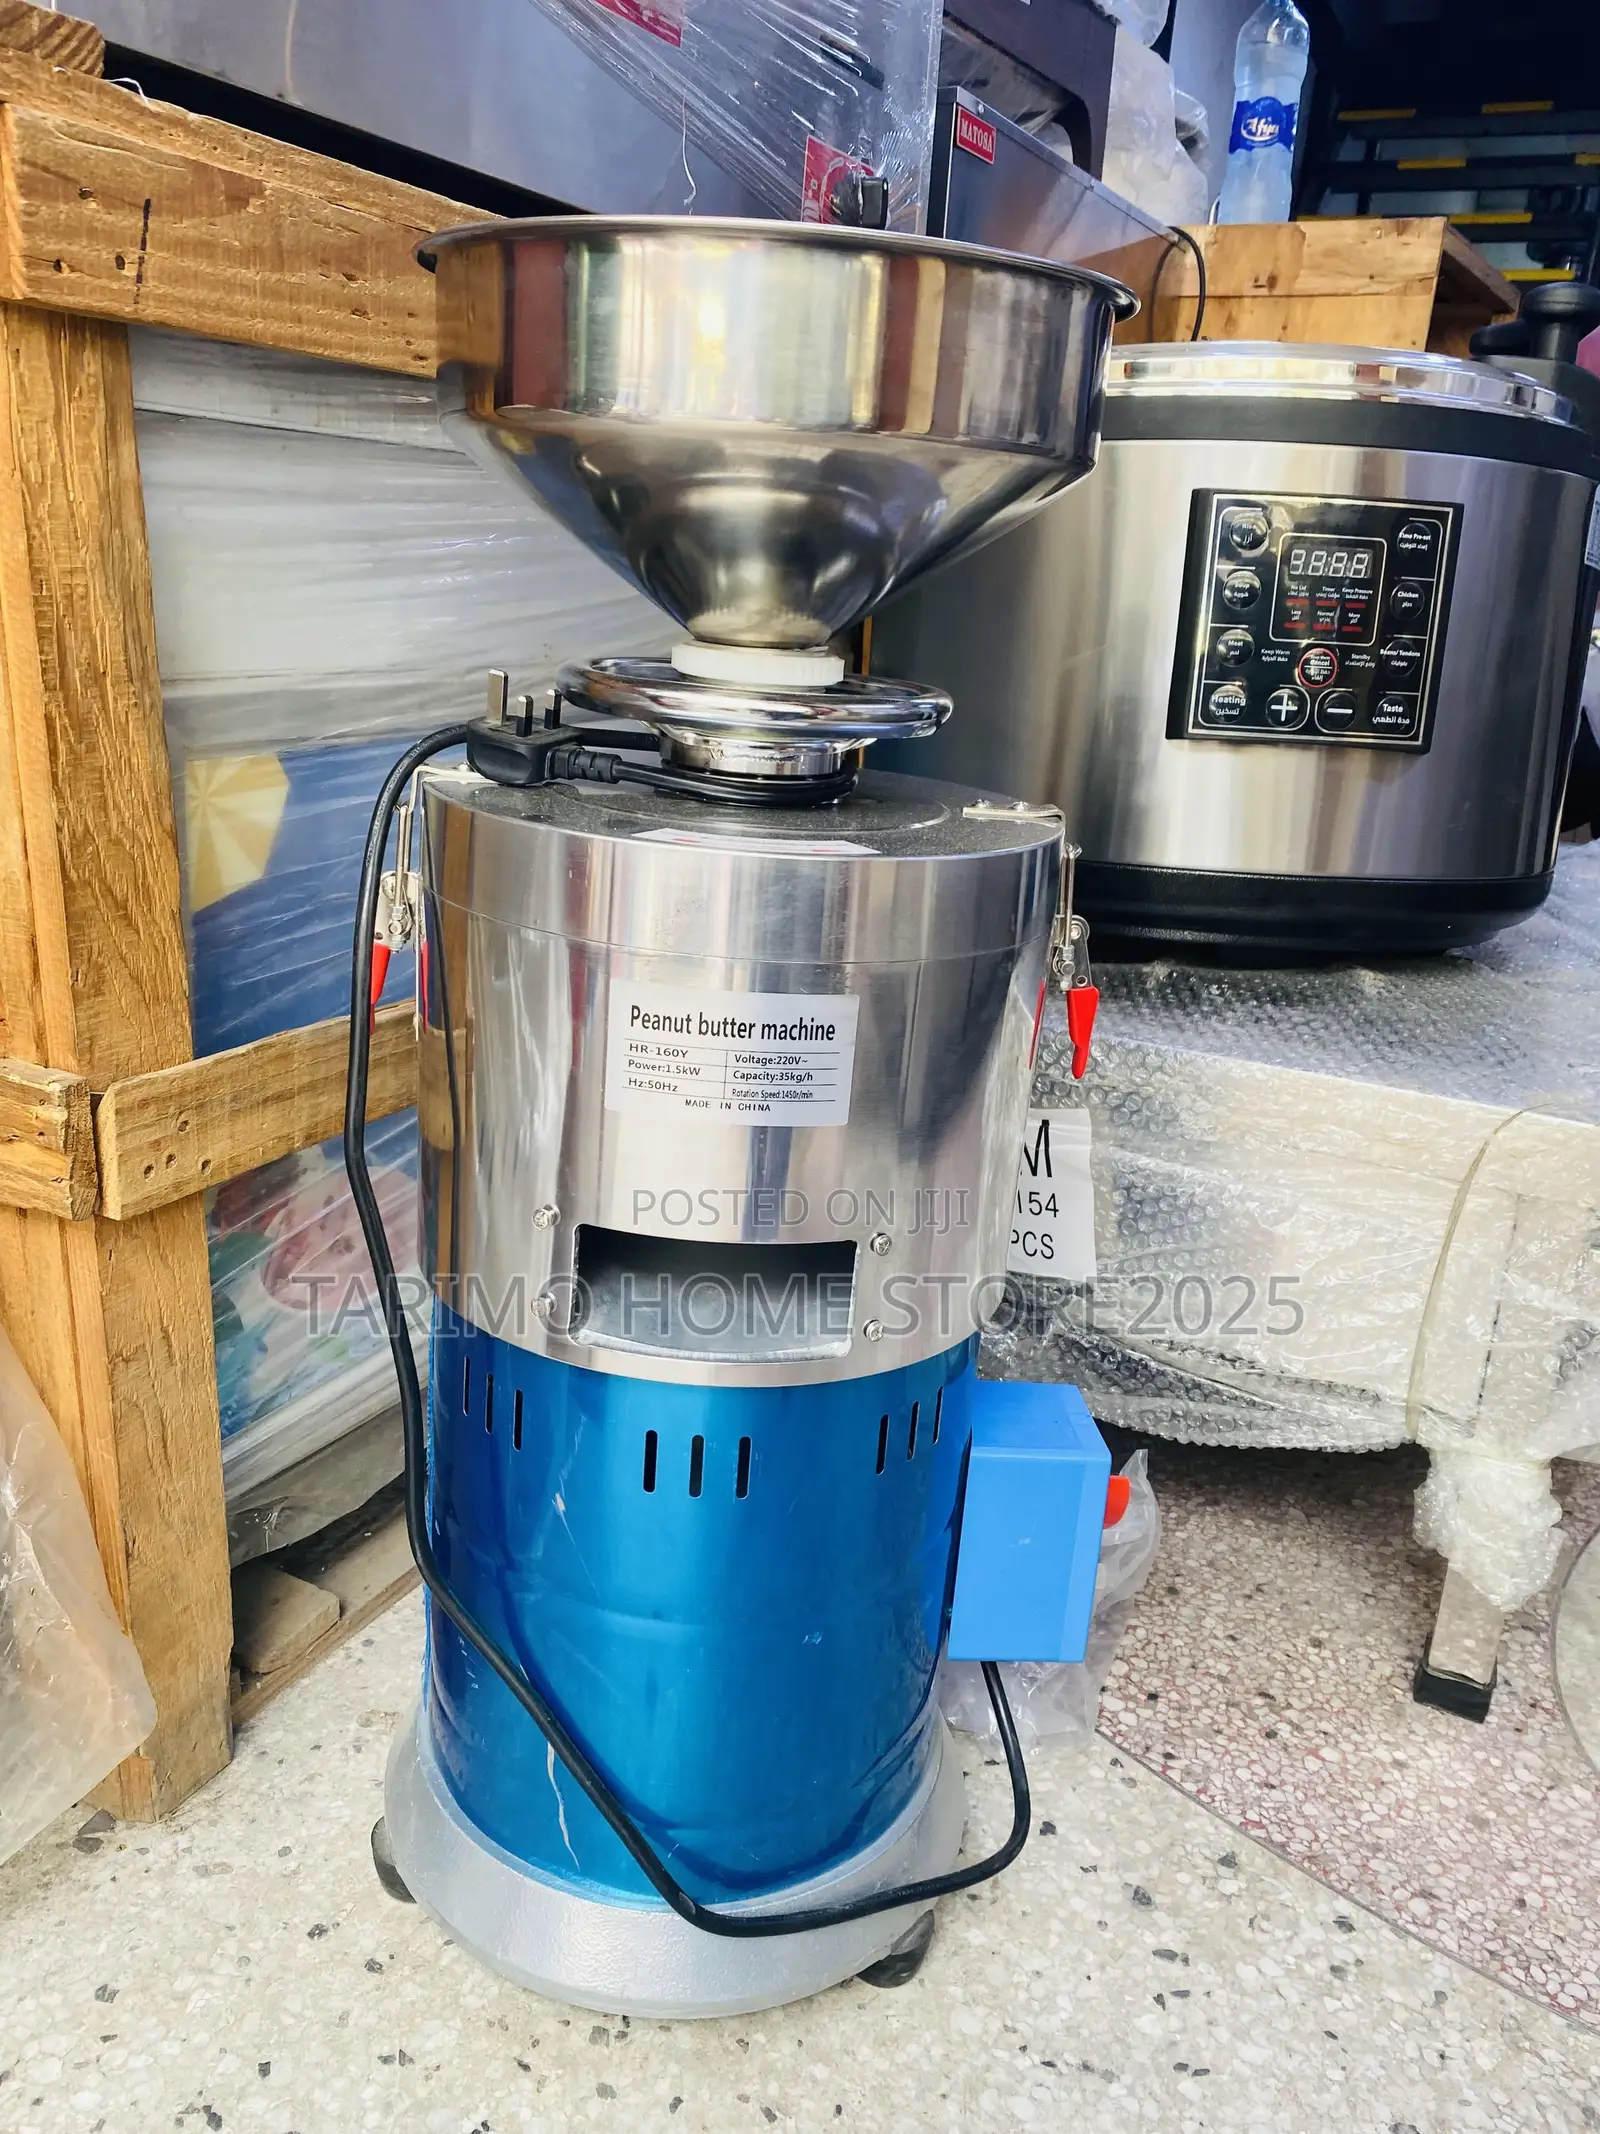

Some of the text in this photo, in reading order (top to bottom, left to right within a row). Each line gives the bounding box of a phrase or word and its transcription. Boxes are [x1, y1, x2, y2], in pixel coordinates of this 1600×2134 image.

[960, 118, 993, 153] MATOSA
[1351, 653, 1370, 661] Standby
[1211, 695, 1246, 706] Heating
[1382, 703, 1403, 713] Taste
[630, 1004, 836, 1041] Peanut butter machine
[629, 1043, 689, 1059] HR-160Y
[628, 1059, 701, 1077] Power:1.5kW
[733, 1070, 813, 1084] Capacity:35kg/h
[628, 1077, 679, 1093] Hz:50Hz
[732, 1088, 814, 1101] Rotation Speed:1450r/min
[684, 1098, 772, 1112] MADE IN CHINA
